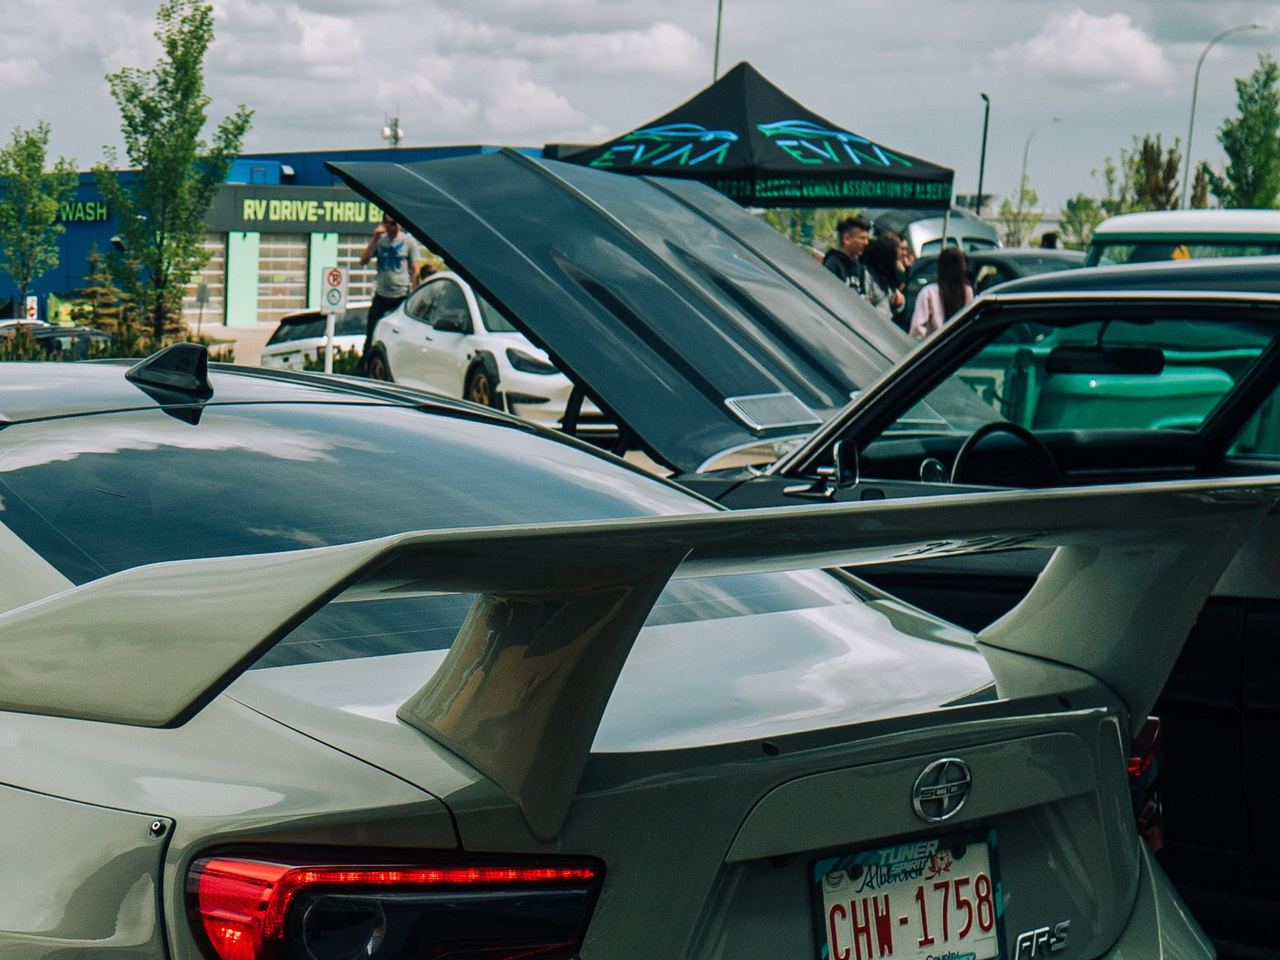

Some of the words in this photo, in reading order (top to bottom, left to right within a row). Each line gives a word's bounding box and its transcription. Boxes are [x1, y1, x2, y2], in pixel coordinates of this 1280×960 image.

[61, 202, 107, 222] WASH
[243, 199, 267, 221] RV
[269, 200, 366, 223] DRIVE-THRU
[878, 839, 939, 866] TUNER
[890, 858, 929, 876] SPIRIT
